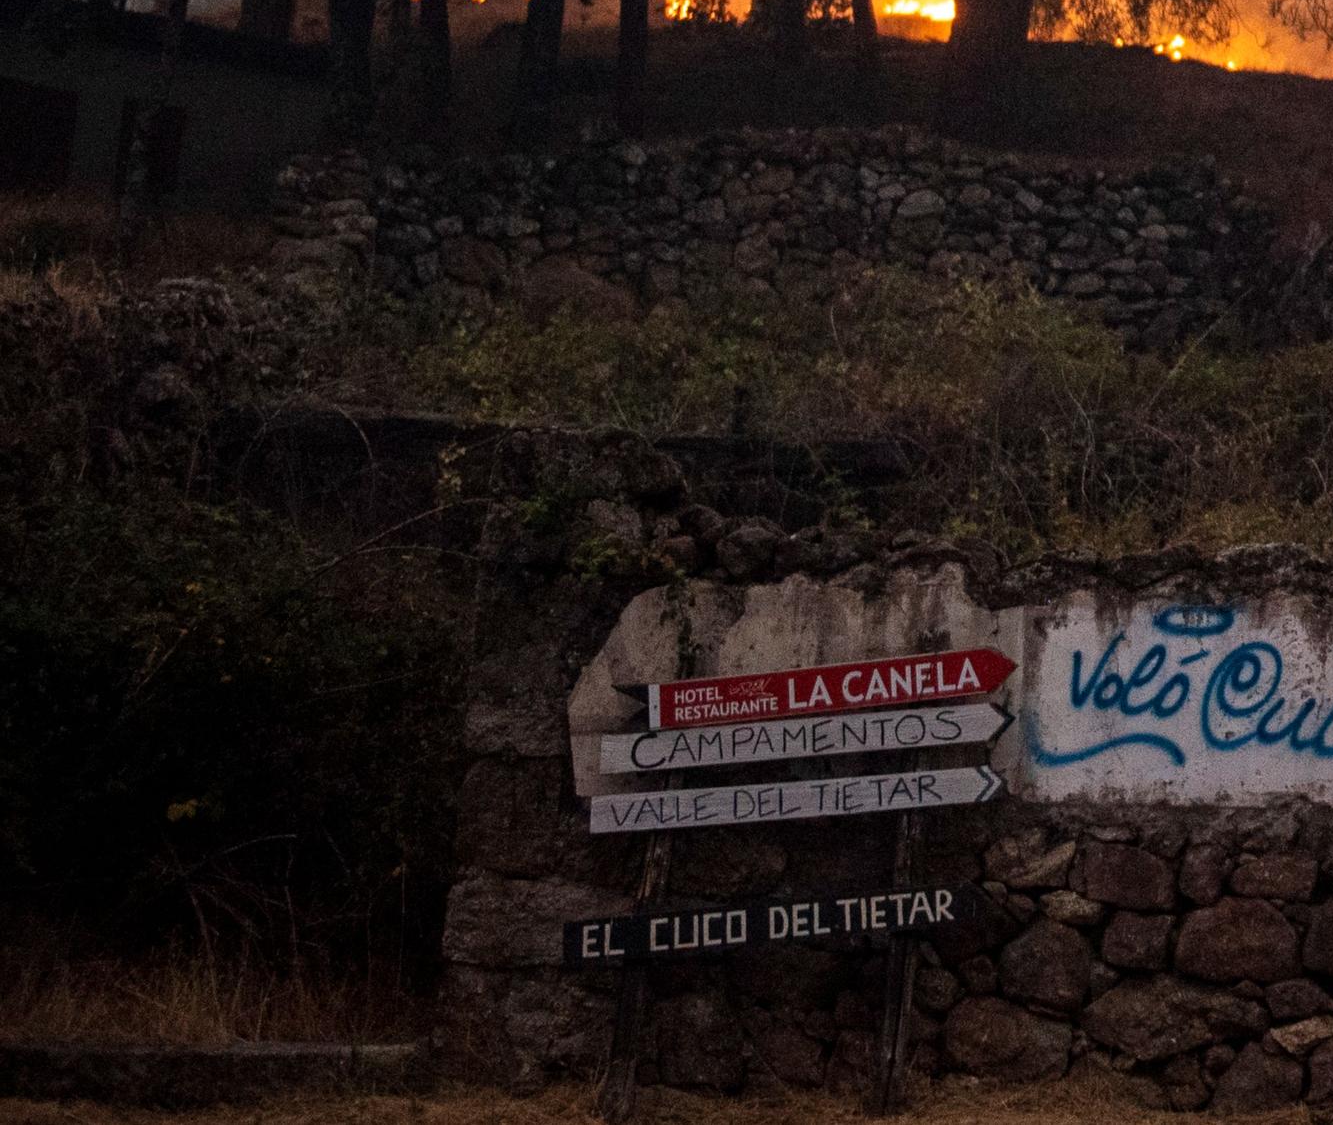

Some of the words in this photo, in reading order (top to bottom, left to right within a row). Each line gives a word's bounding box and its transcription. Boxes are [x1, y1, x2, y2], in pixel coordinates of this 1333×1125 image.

[675, 686, 723, 704] HOTEL
[788, 677, 832, 710] LA
[842, 657, 981, 704] CANELA
[1070, 631, 1209, 719] Voló
[675, 697, 779, 721] RESTAURANTE
[630, 710, 962, 769] CAMPAMENTOS
[610, 790, 719, 827] VALLE
[733, 788, 800, 821] DEL
[582, 924, 625, 959] EL
[650, 909, 747, 952] CUCO
[769, 904, 831, 940] DEL
[836, 889, 955, 930] TIETAR
